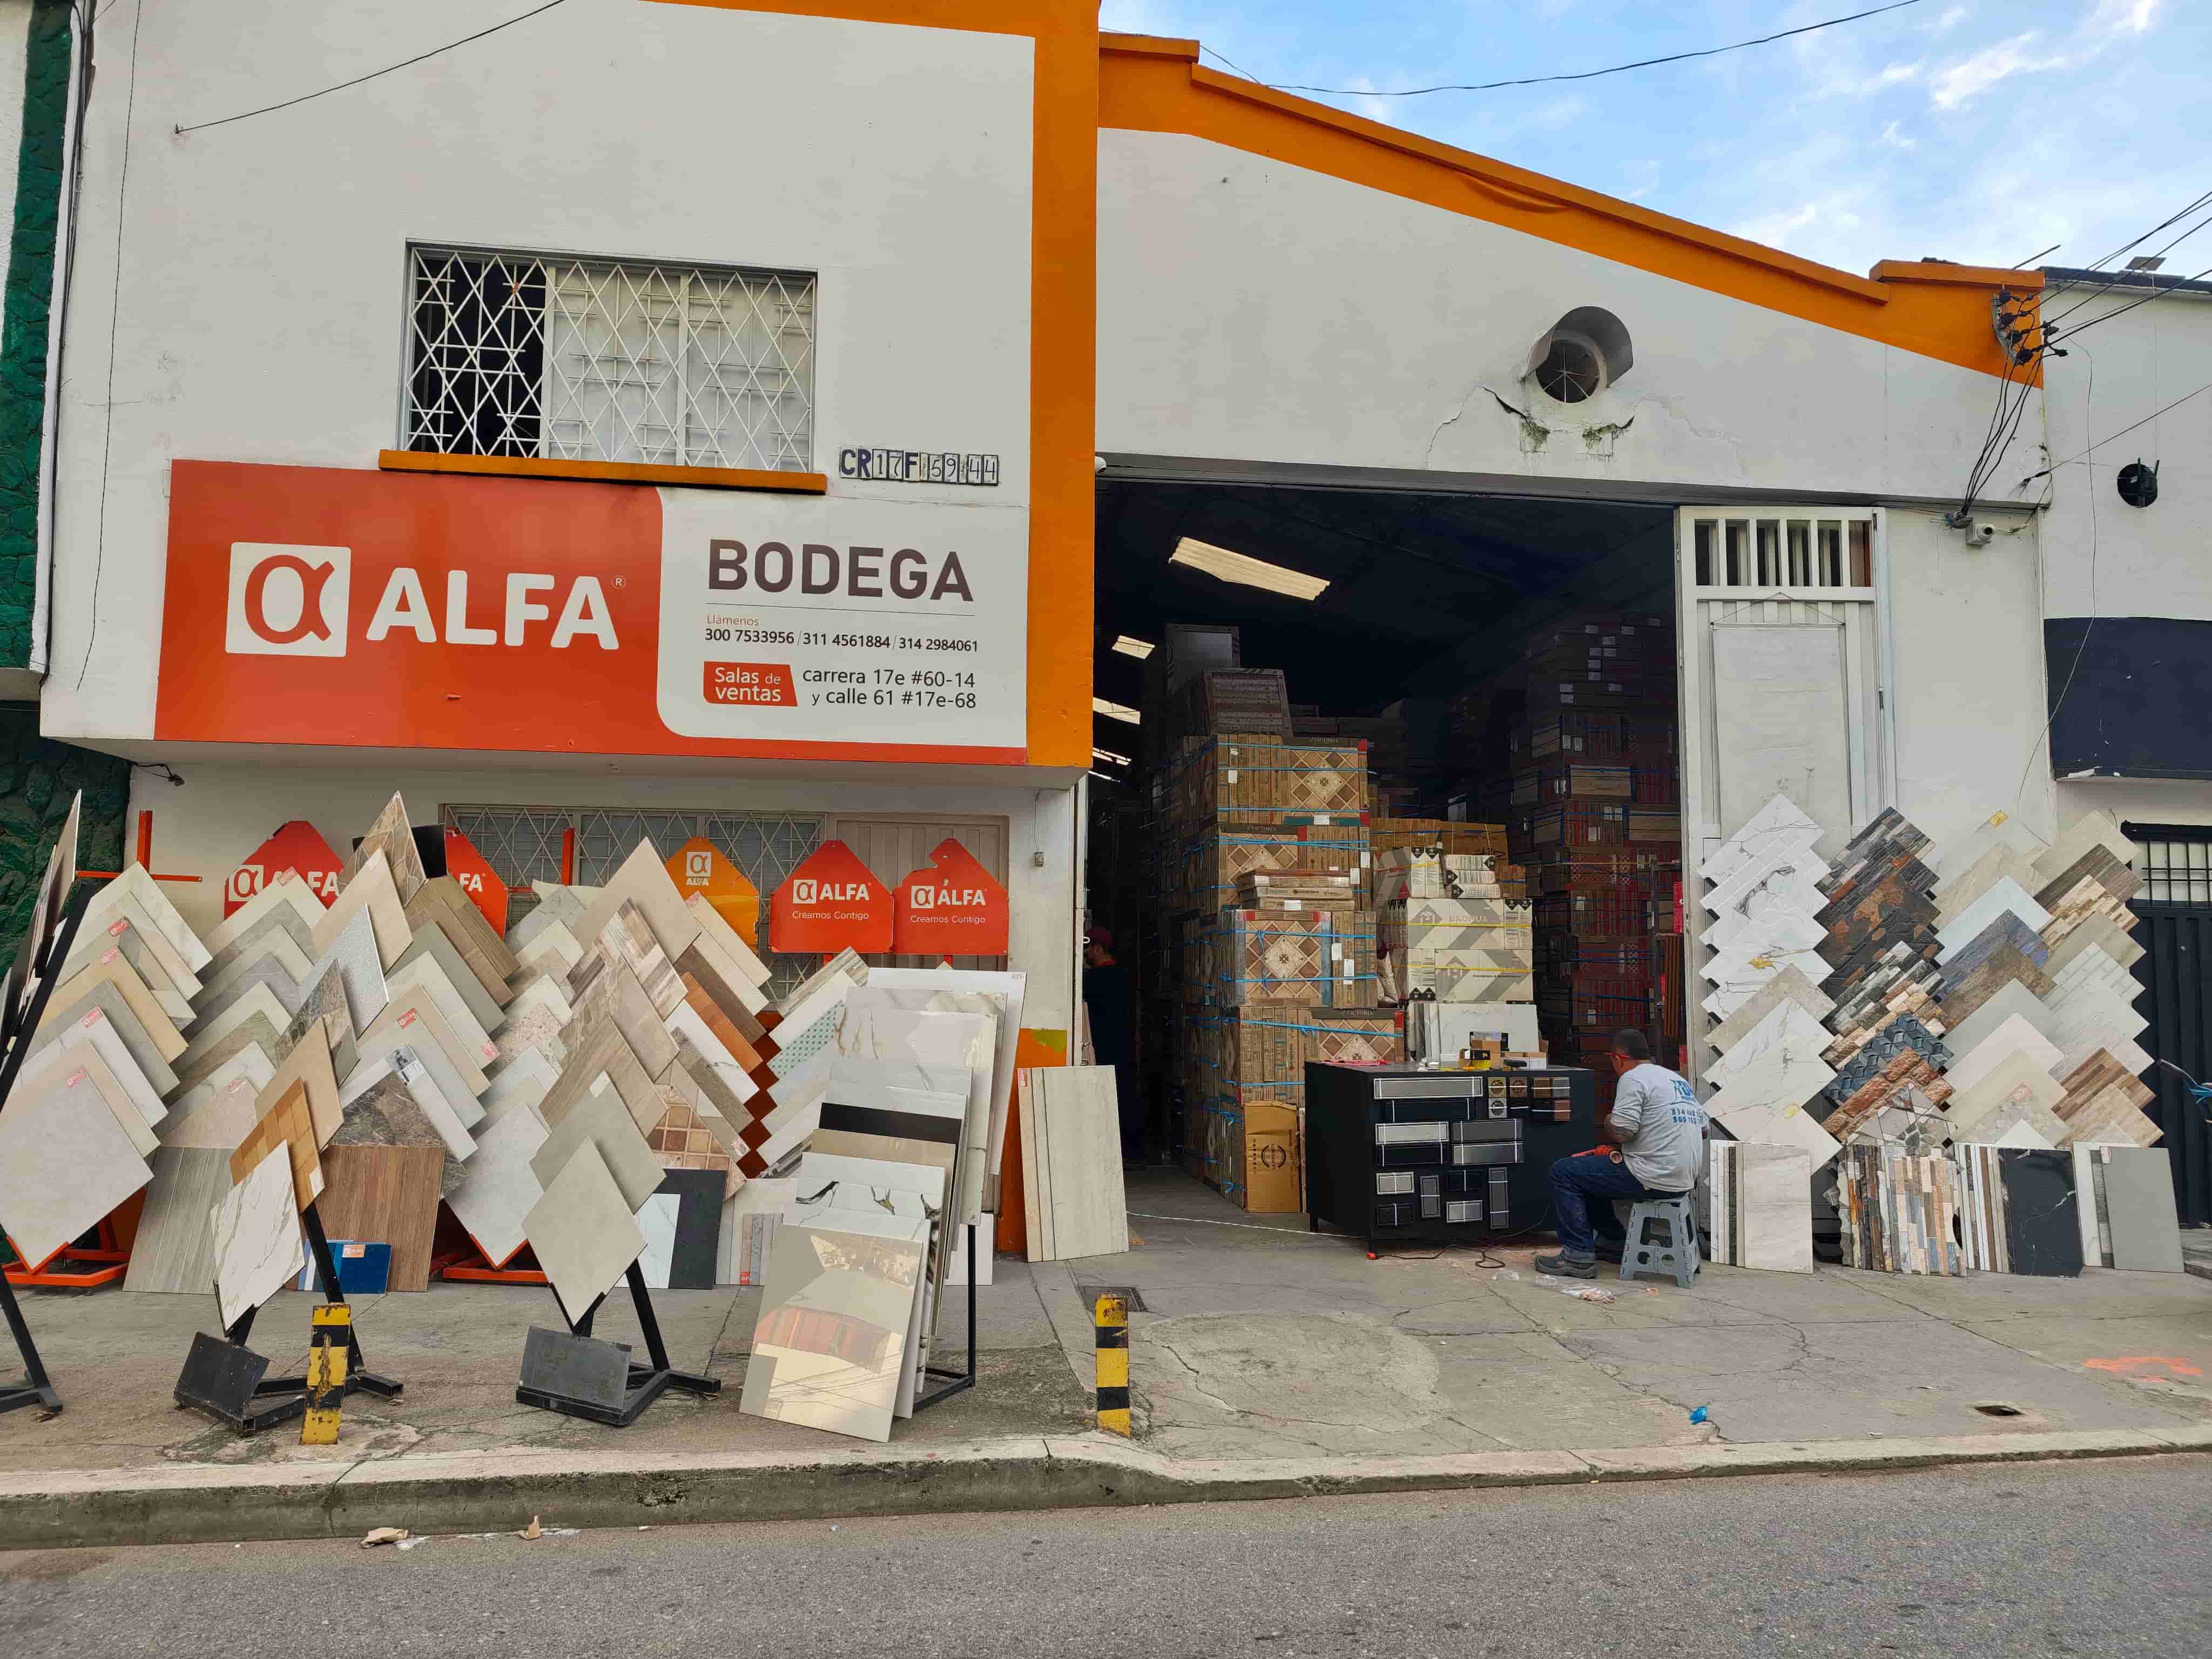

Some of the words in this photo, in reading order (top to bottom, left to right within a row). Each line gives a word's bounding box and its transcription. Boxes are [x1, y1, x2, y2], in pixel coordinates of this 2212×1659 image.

[708, 538, 974, 602] BODEGA
[366, 568, 619, 650] ALFA
[706, 614, 759, 626] Llámenos
[705, 628, 731, 641] 300
[926, 638, 978, 652] 2984061
[714, 667, 759, 683] Salas
[765, 673, 781, 684] de
[802, 669, 866, 684] carrera
[873, 669, 906, 685] 17e
[911, 670, 976, 688] #60-14
[715, 685, 782, 702] ventas
[812, 693, 820, 706] y
[826, 687, 867, 705] calle
[873, 689, 893, 705] 61
[901, 691, 976, 709] #17e-68
[819, 884, 870, 901] ALFA
[937, 889, 986, 906] ALFA
[792, 911, 831, 920] Creamos
[834, 911, 869, 921] Contigo
[910, 915, 949, 923] Creamos
[951, 915, 986, 925] Contigo
